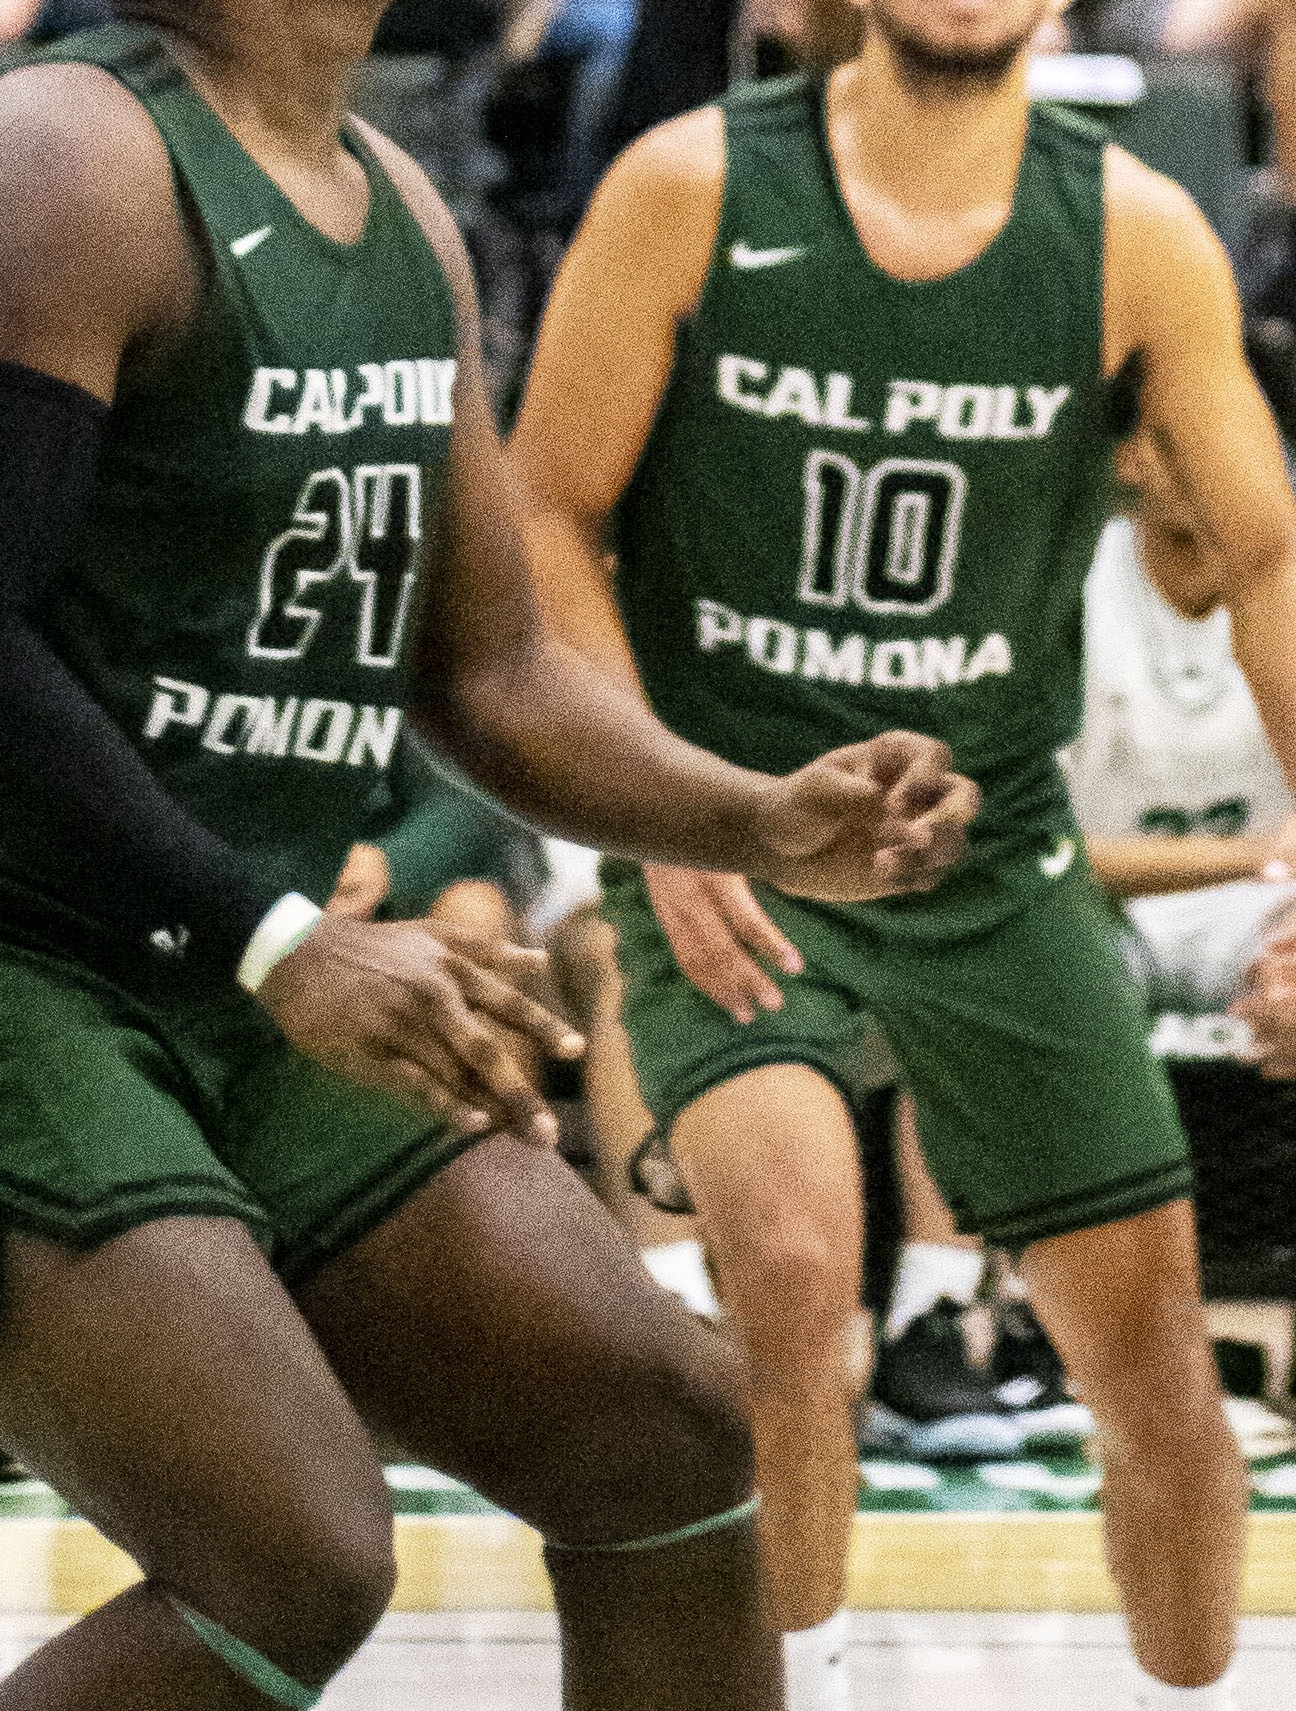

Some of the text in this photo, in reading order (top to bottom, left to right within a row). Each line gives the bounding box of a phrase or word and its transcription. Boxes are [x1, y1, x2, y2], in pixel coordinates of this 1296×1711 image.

[242, 366, 362, 434] CAL
[716, 353, 1072, 440] CAL POLY
[247, 463, 421, 669] 24
[797, 449, 969, 617] 10
[695, 598, 1013, 690] POMONA
[142, 675, 403, 770] POMON
